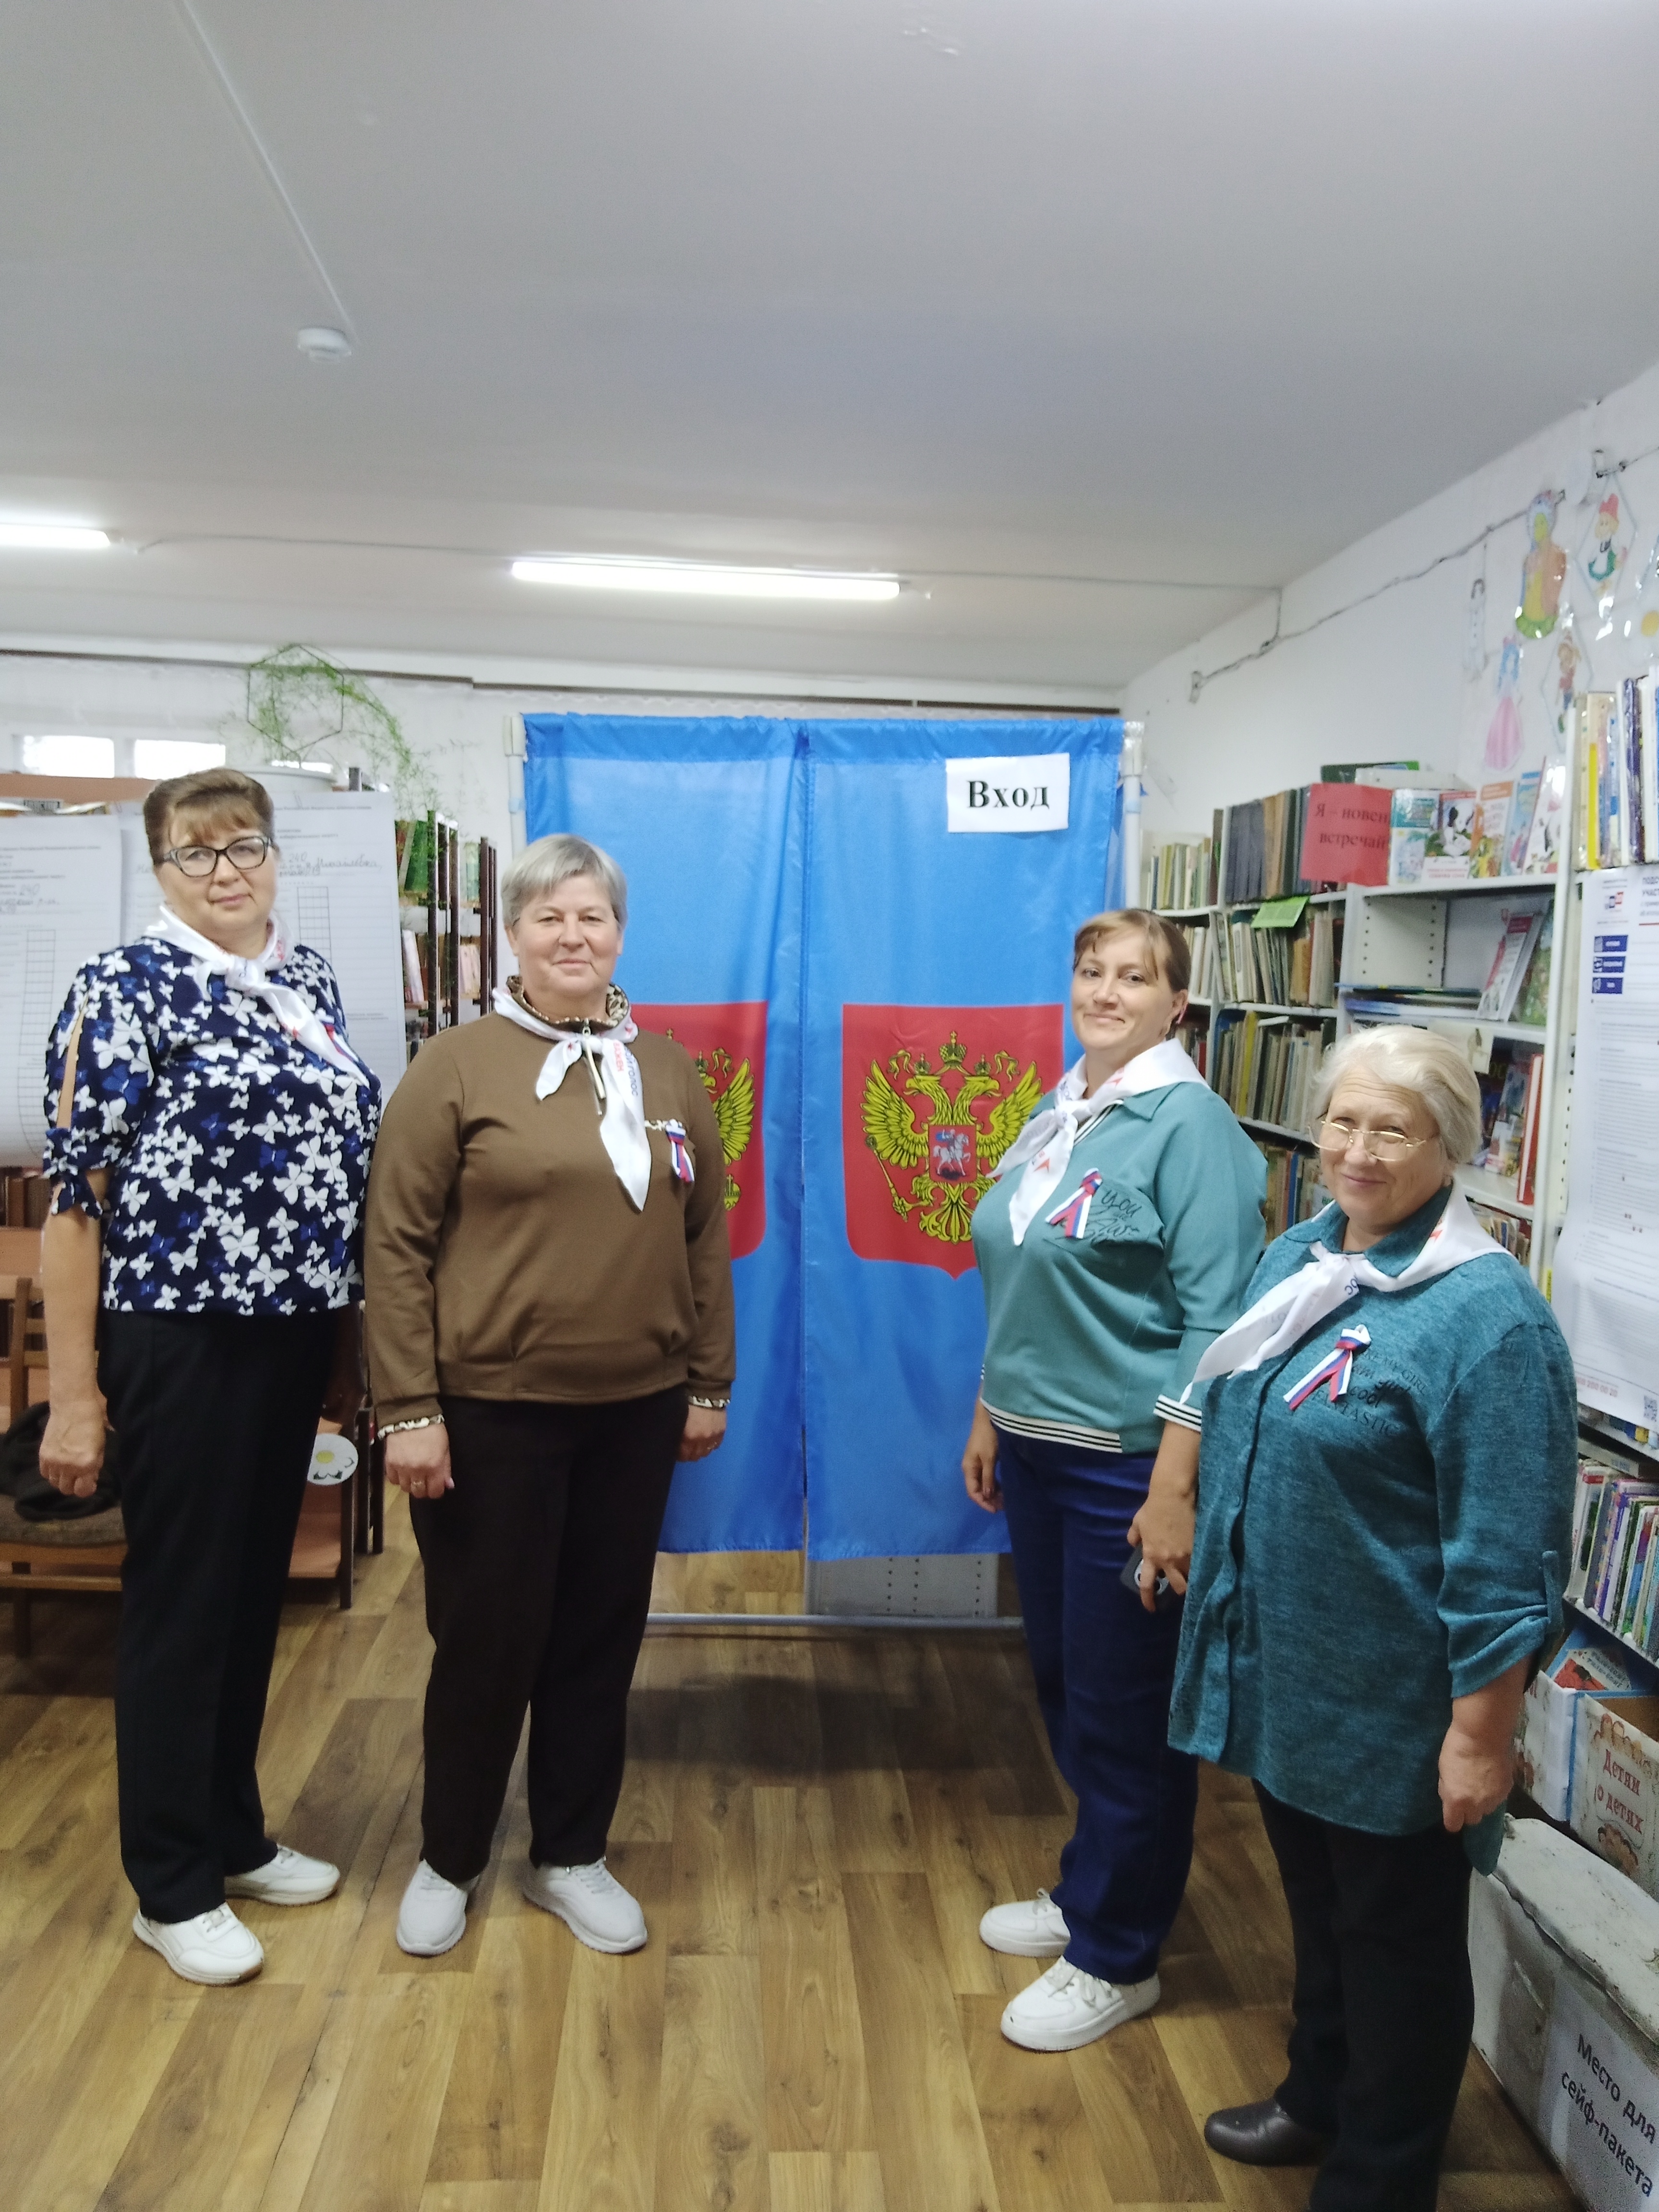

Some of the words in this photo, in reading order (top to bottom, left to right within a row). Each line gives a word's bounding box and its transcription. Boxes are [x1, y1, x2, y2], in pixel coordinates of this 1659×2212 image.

[967, 780, 1050, 811] Вход
[1316, 804, 1325, 817] Я
[1577, 2033, 1621, 2102] Место
[1623, 2099, 1656, 2144] для
[1561, 2071, 1653, 2198] сейф-пакета
